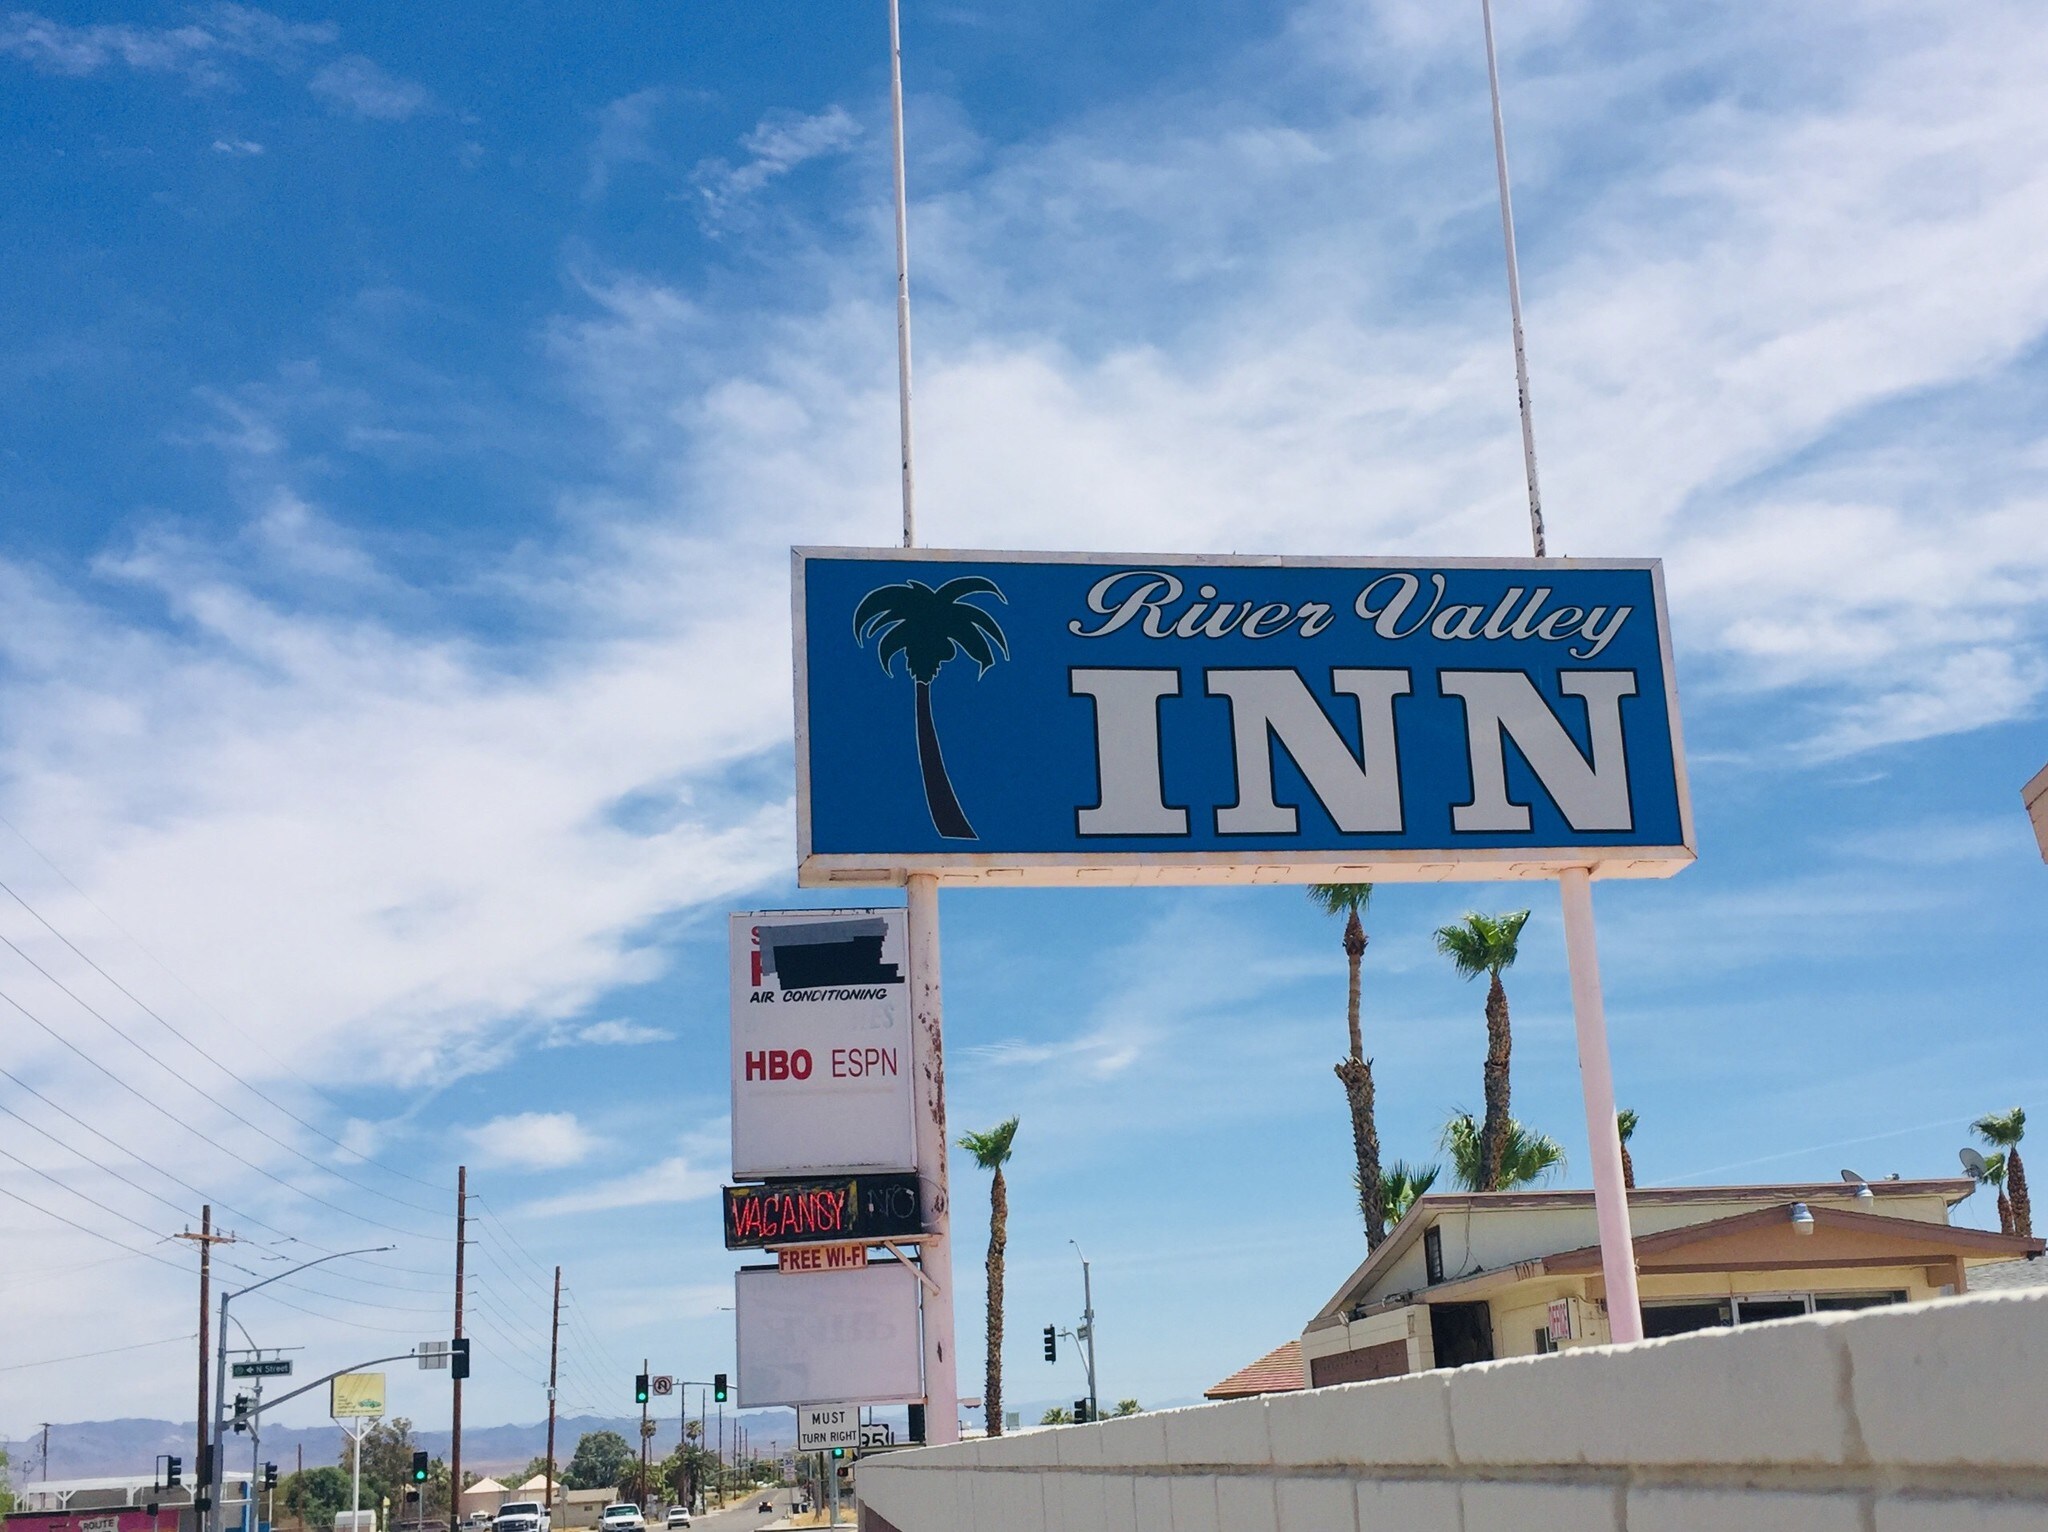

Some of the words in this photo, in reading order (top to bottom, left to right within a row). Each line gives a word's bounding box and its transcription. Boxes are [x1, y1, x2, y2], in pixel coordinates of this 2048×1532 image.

[1068, 569, 1336, 641] River
[1354, 571, 1636, 661] Valley
[1069, 667, 1639, 837] INN
[750, 991, 775, 1003] AIR
[783, 988, 888, 1002] CONDITIONING
[745, 1048, 813, 1081] HBO
[832, 1047, 898, 1078] ESPN
[780, 1248, 822, 1271] FREE
[827, 1245, 867, 1268] WI-FI
[256, 1365, 263, 1373] N
[265, 1364, 289, 1373] Street
[812, 1411, 846, 1425] MUST
[802, 1432, 827, 1444] TURN
[830, 1430, 857, 1442] RIGHT
[83, 1518, 115, 1530] ROUTE
